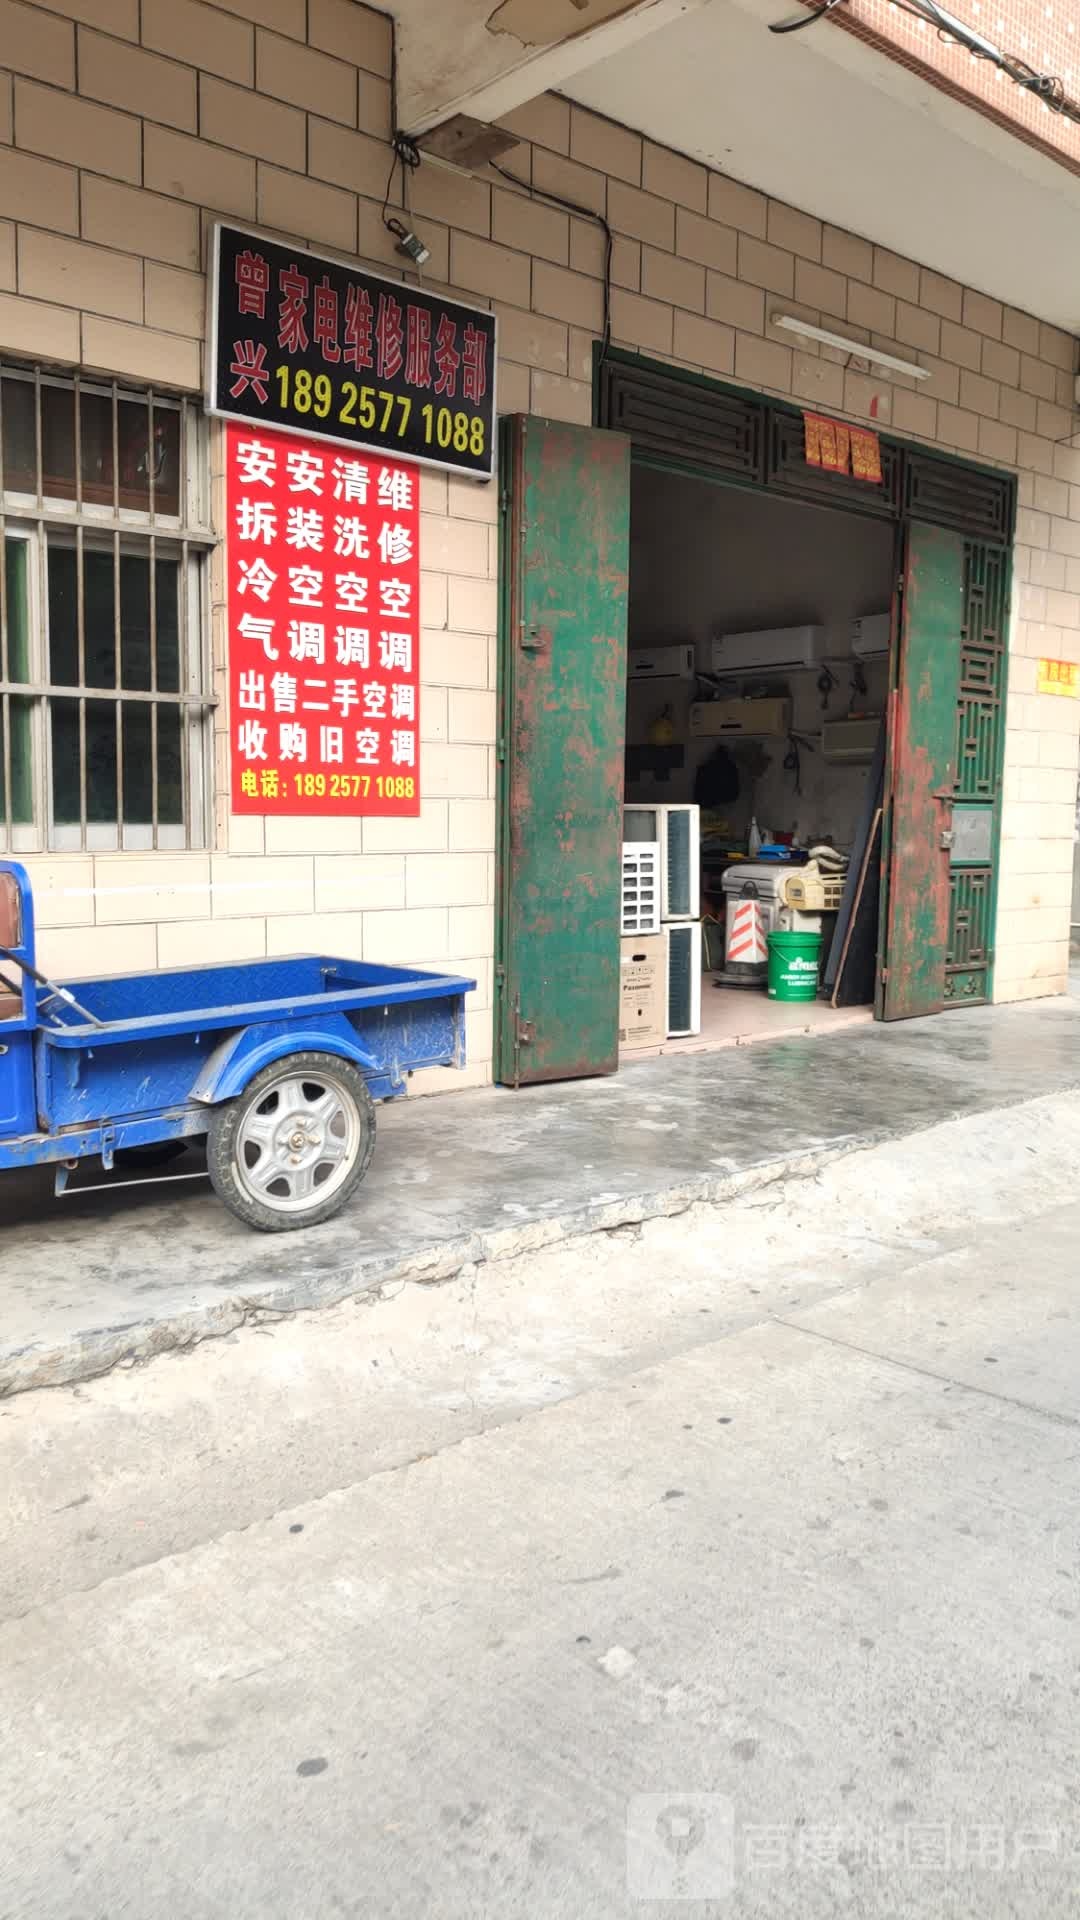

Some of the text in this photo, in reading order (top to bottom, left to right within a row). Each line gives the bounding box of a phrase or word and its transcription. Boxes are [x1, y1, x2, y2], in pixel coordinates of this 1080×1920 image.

[275, 365, 485, 457] 189 2577 1088
[238, 670, 415, 721] 出售二手空调
[237, 719, 415, 767] 收购旧空调
[294, 773, 326, 797] 189
[330, 775, 371, 798] 2577
[376, 776, 415, 799] 1088
